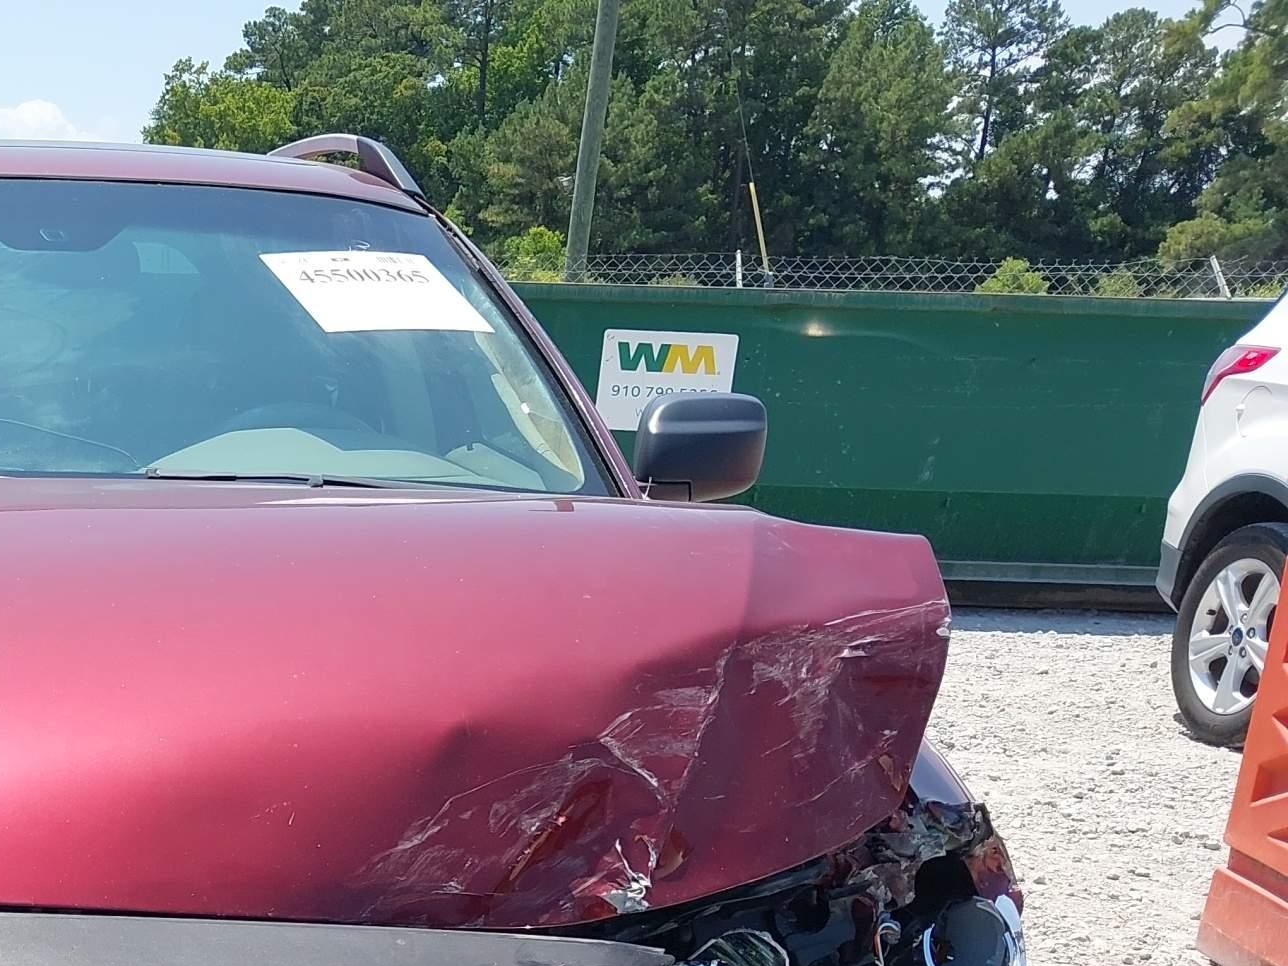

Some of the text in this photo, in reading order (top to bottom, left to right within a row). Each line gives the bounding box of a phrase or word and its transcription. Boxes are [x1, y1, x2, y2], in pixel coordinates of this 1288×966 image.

[299, 268, 430, 283] 45500365
[618, 341, 716, 375] WM
[611, 384, 641, 397] 910
